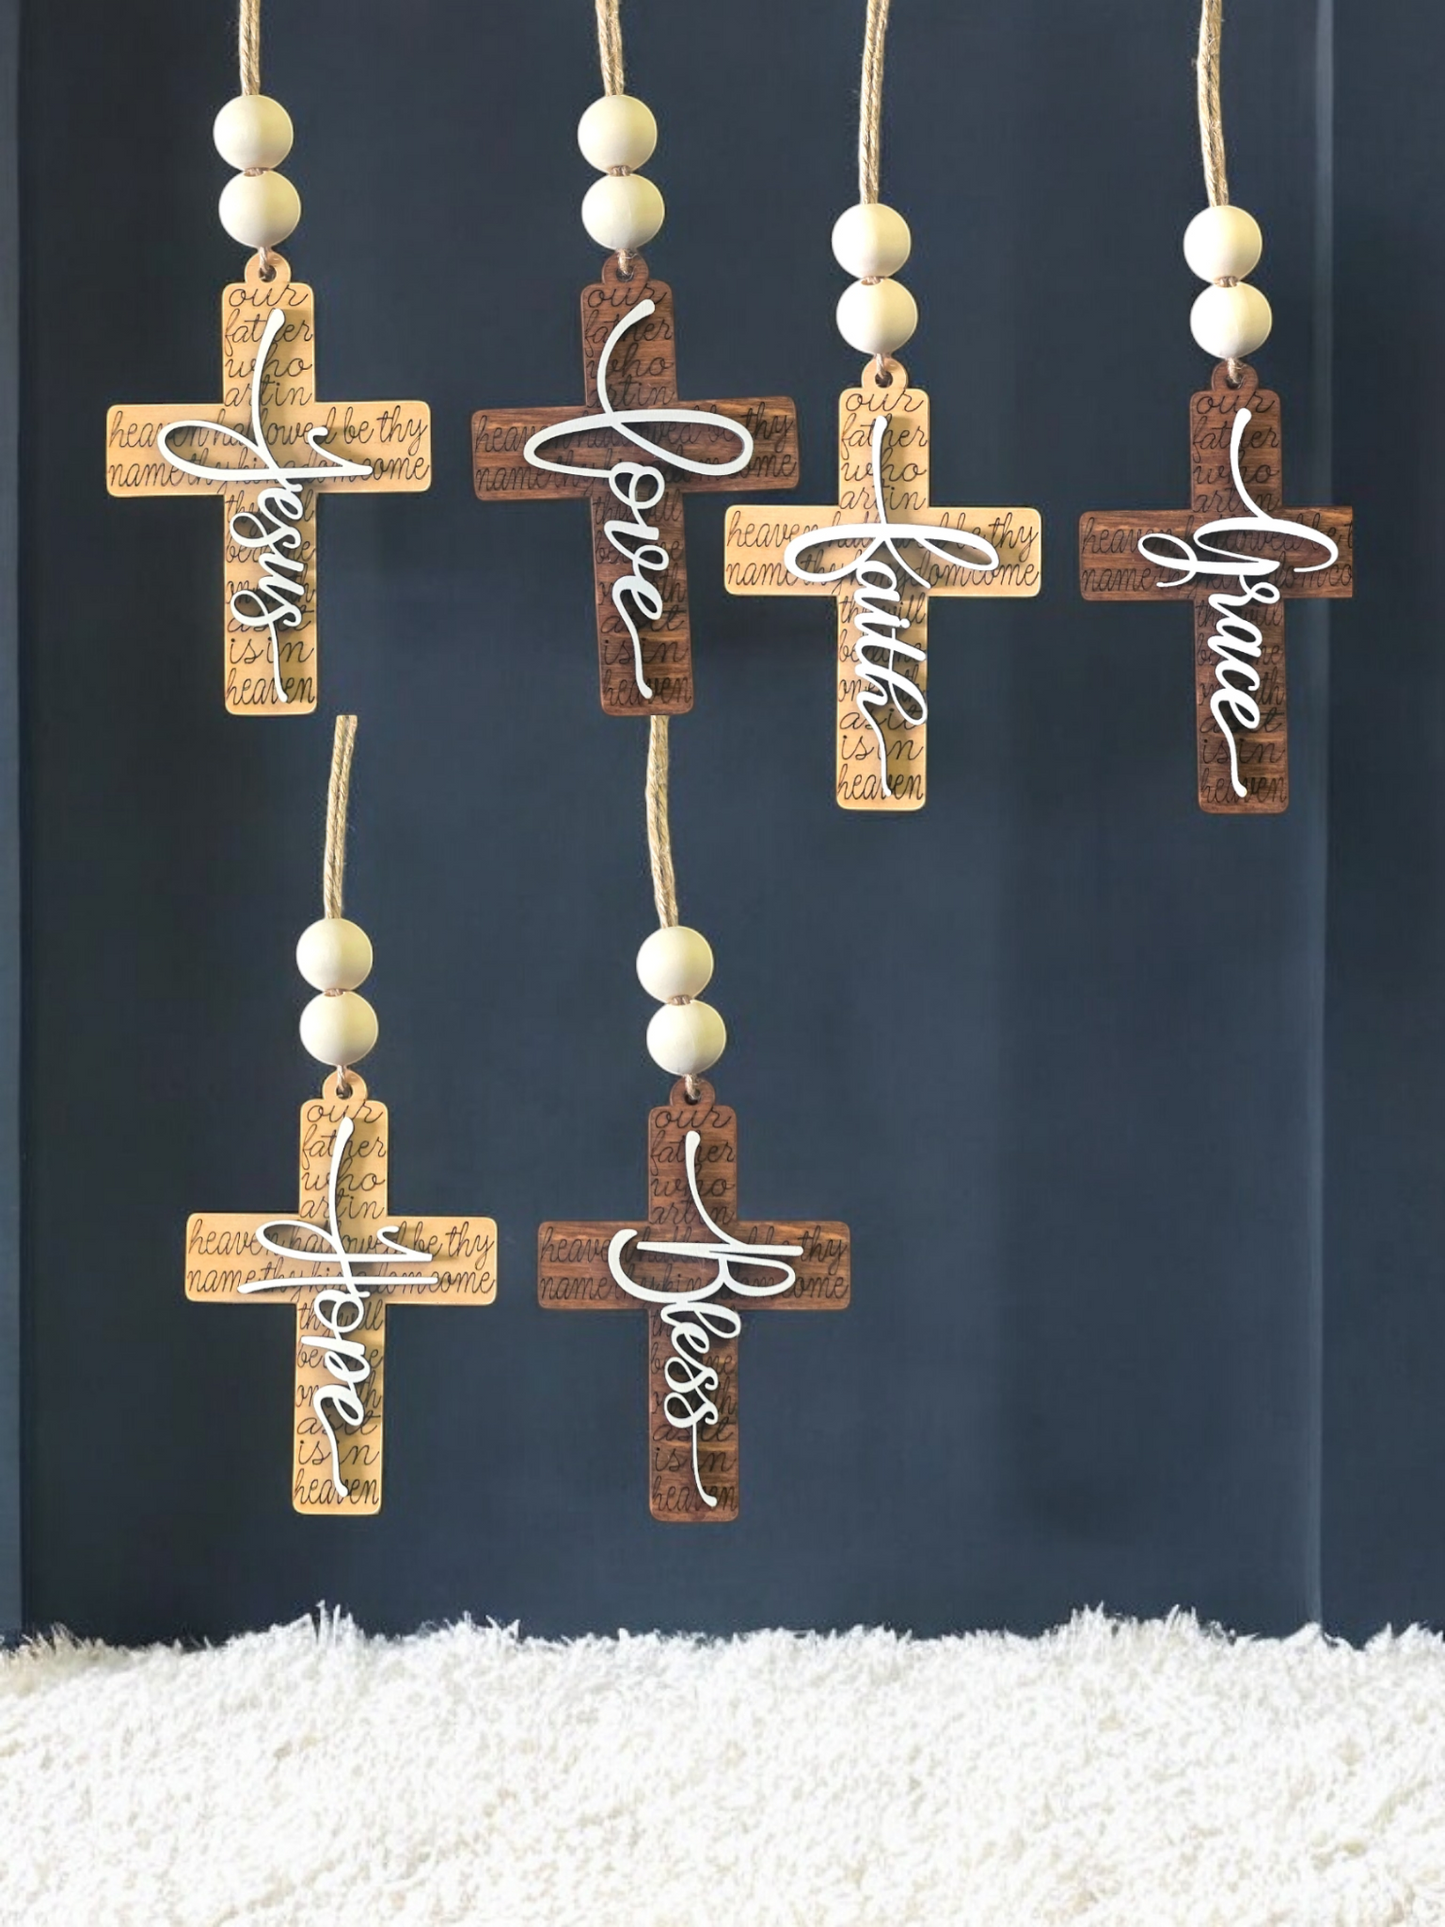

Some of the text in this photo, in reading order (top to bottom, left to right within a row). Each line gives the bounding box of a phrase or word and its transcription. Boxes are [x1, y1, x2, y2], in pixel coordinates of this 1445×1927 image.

[228, 284, 309, 308] our
[587, 283, 668, 309] our
[224, 308, 313, 357] fater
[846, 387, 924, 413] our
[1197, 391, 1276, 415] our
[343, 406, 375, 444] be
[376, 405, 428, 457] thy
[1192, 416, 1280, 464] fater
[140, 308, 373, 702] Jesus
[523, 299, 754, 699] Love
[1243, 492, 1280, 513] n
[988, 511, 1040, 563] thy
[1081, 567, 1152, 592] name
[783, 414, 999, 797] Faith
[1138, 408, 1339, 797] Grace
[306, 1099, 384, 1124] our
[654, 1105, 732, 1129] our
[698, 1205, 736, 1225] n
[445, 1220, 495, 1271] thy
[539, 1226, 635, 1263] heave
[797, 1225, 848, 1276] thy
[430, 1270, 496, 1295] come
[539, 1277, 610, 1300] name
[608, 1131, 804, 1506] Bless
[336, 1439, 380, 1466] n
